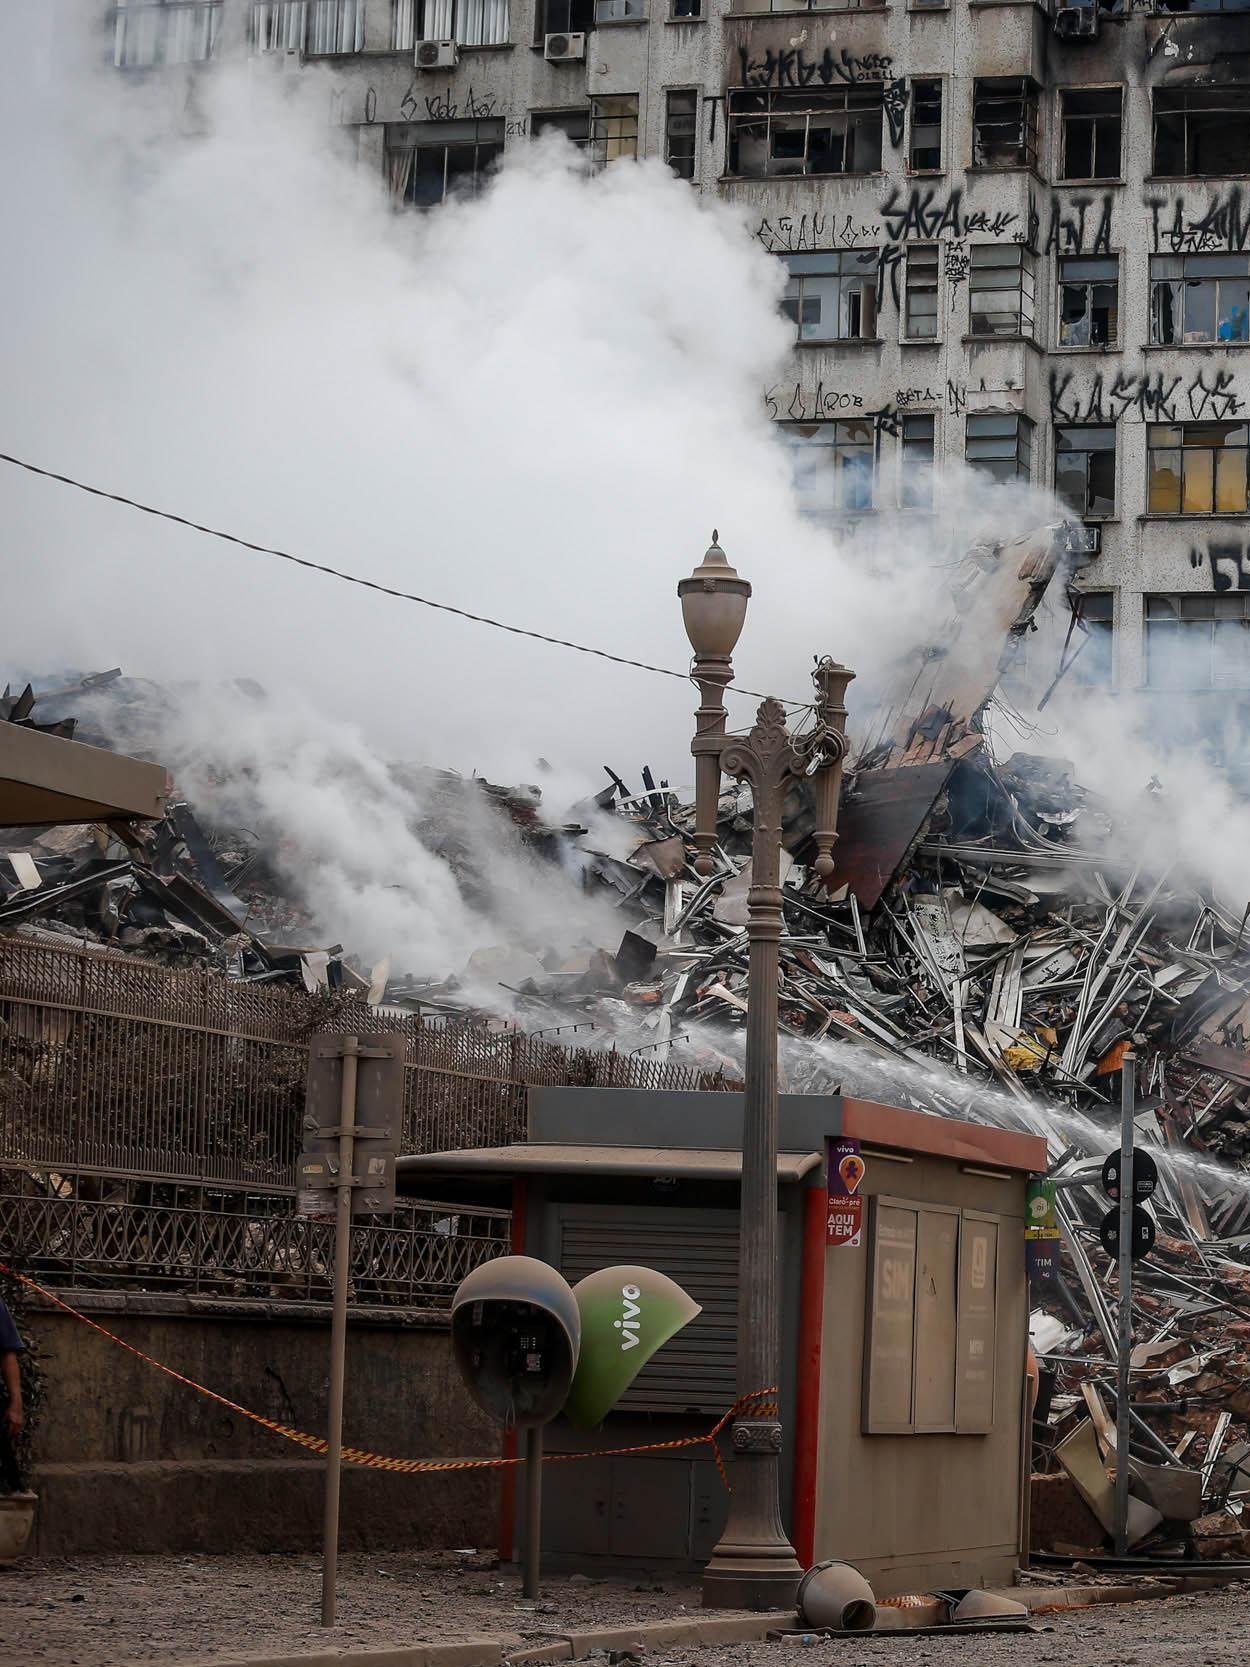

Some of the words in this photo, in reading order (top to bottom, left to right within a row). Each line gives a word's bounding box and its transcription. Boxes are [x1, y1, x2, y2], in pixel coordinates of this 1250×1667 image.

[881, 188, 963, 241] SAGA
[837, 1145, 854, 1153] vivo
[827, 1214, 855, 1225] AQUI
[828, 1224, 852, 1236] TEM
[1035, 1258, 1052, 1267] TIM
[613, 1283, 641, 1351] vivo
